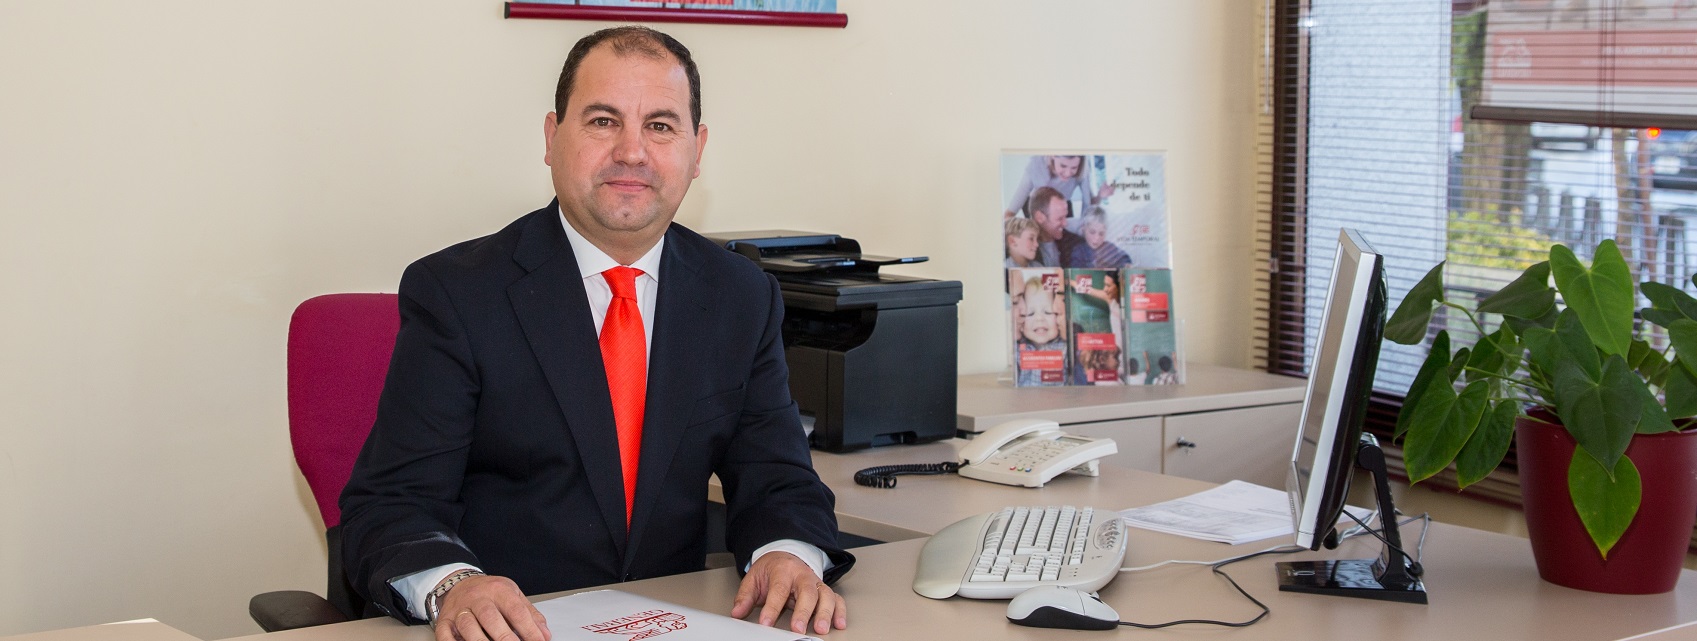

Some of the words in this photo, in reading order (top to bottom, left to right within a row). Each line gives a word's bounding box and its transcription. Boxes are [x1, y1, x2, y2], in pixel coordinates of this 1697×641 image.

[1125, 167, 1149, 176] Todo
[1110, 180, 1150, 191] depende
[1129, 192, 1140, 201] de
[1144, 193, 1151, 201] ti
[580, 609, 664, 631] GENERALI
